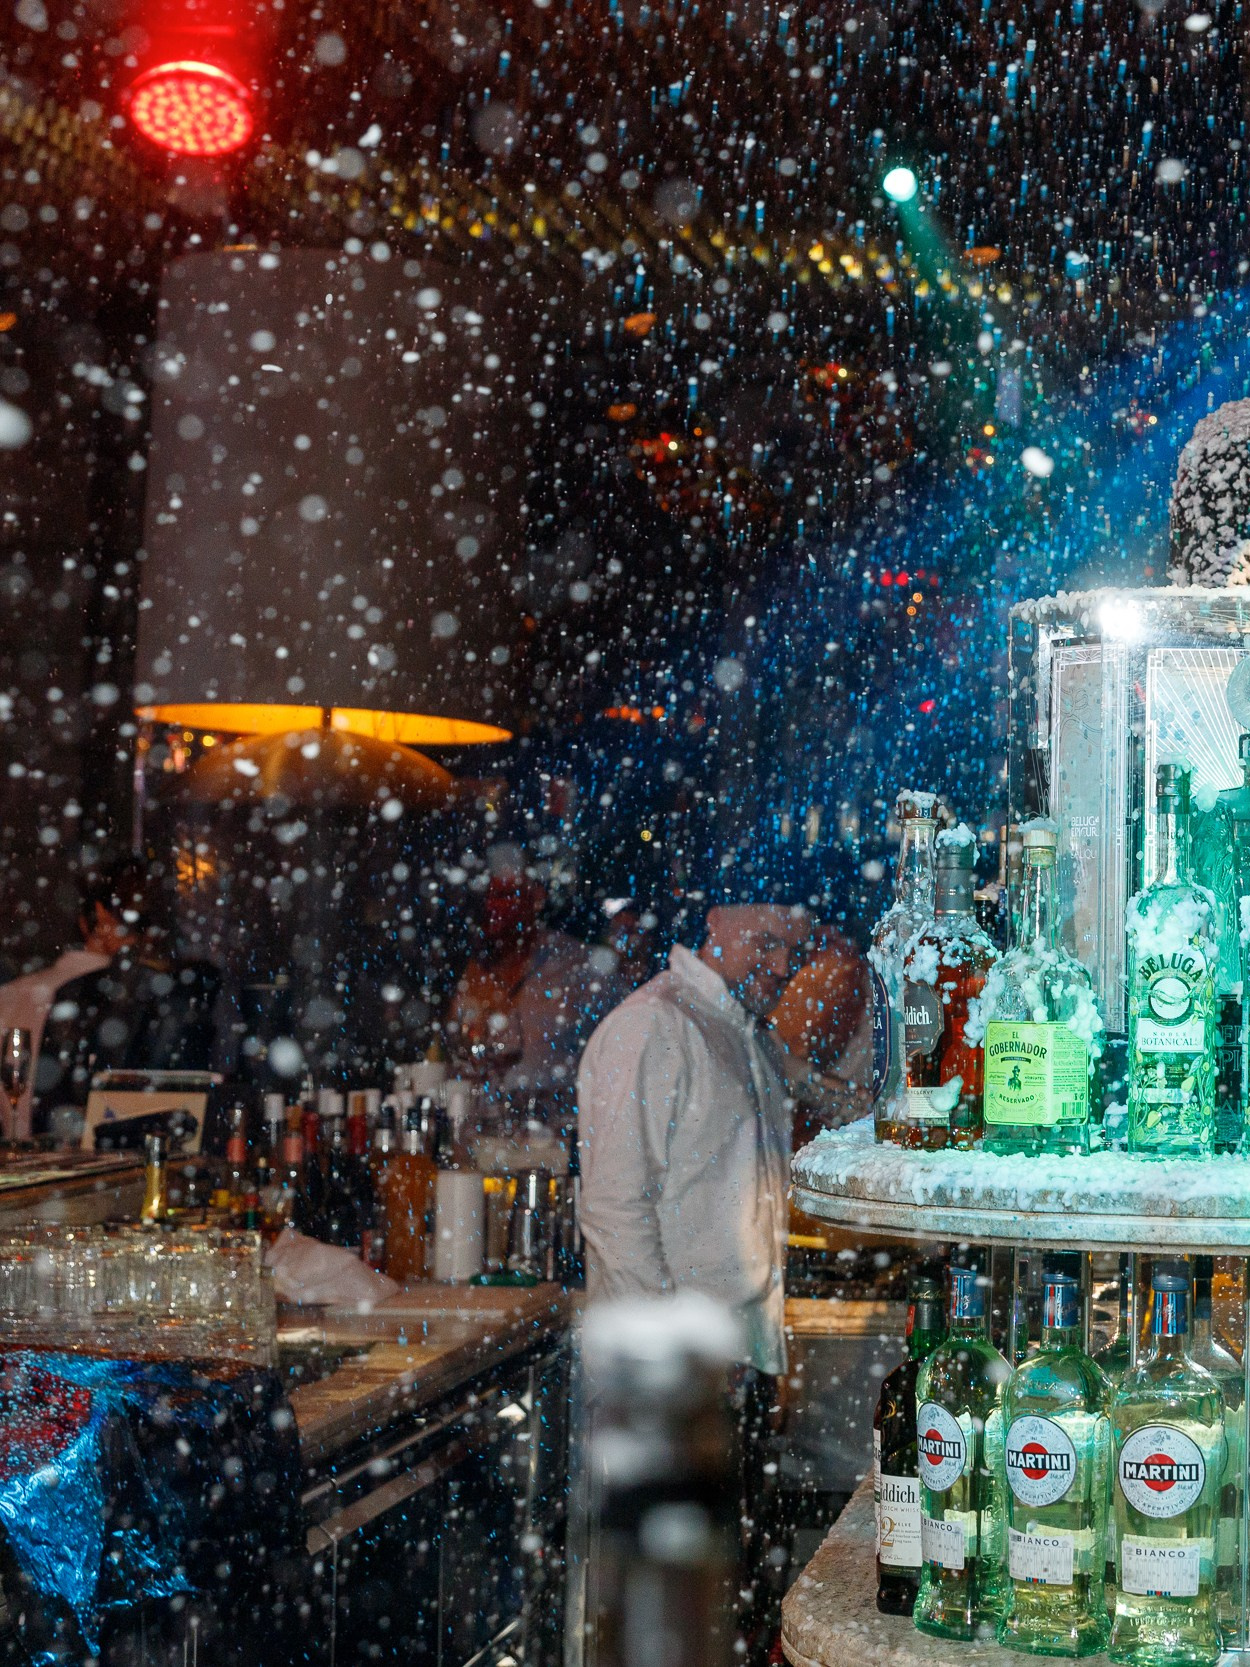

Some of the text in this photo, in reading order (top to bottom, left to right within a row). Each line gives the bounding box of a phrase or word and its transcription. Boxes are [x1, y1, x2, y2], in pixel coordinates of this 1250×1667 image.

[1138, 953, 1203, 982] BELUGA
[1012, 1031, 1019, 1039] EL
[989, 1041, 1047, 1059] GOBERNADOR
[999, 1093, 1035, 1104] RESERVADO
[919, 1438, 959, 1458] MARTINI
[1008, 1451, 1068, 1470] MARTINI
[1125, 1463, 1197, 1481] MARTINI
[924, 1519, 952, 1532] BIANCO
[1017, 1536, 1059, 1547] BIANCO
[1135, 1548, 1186, 1558] BIANCO
